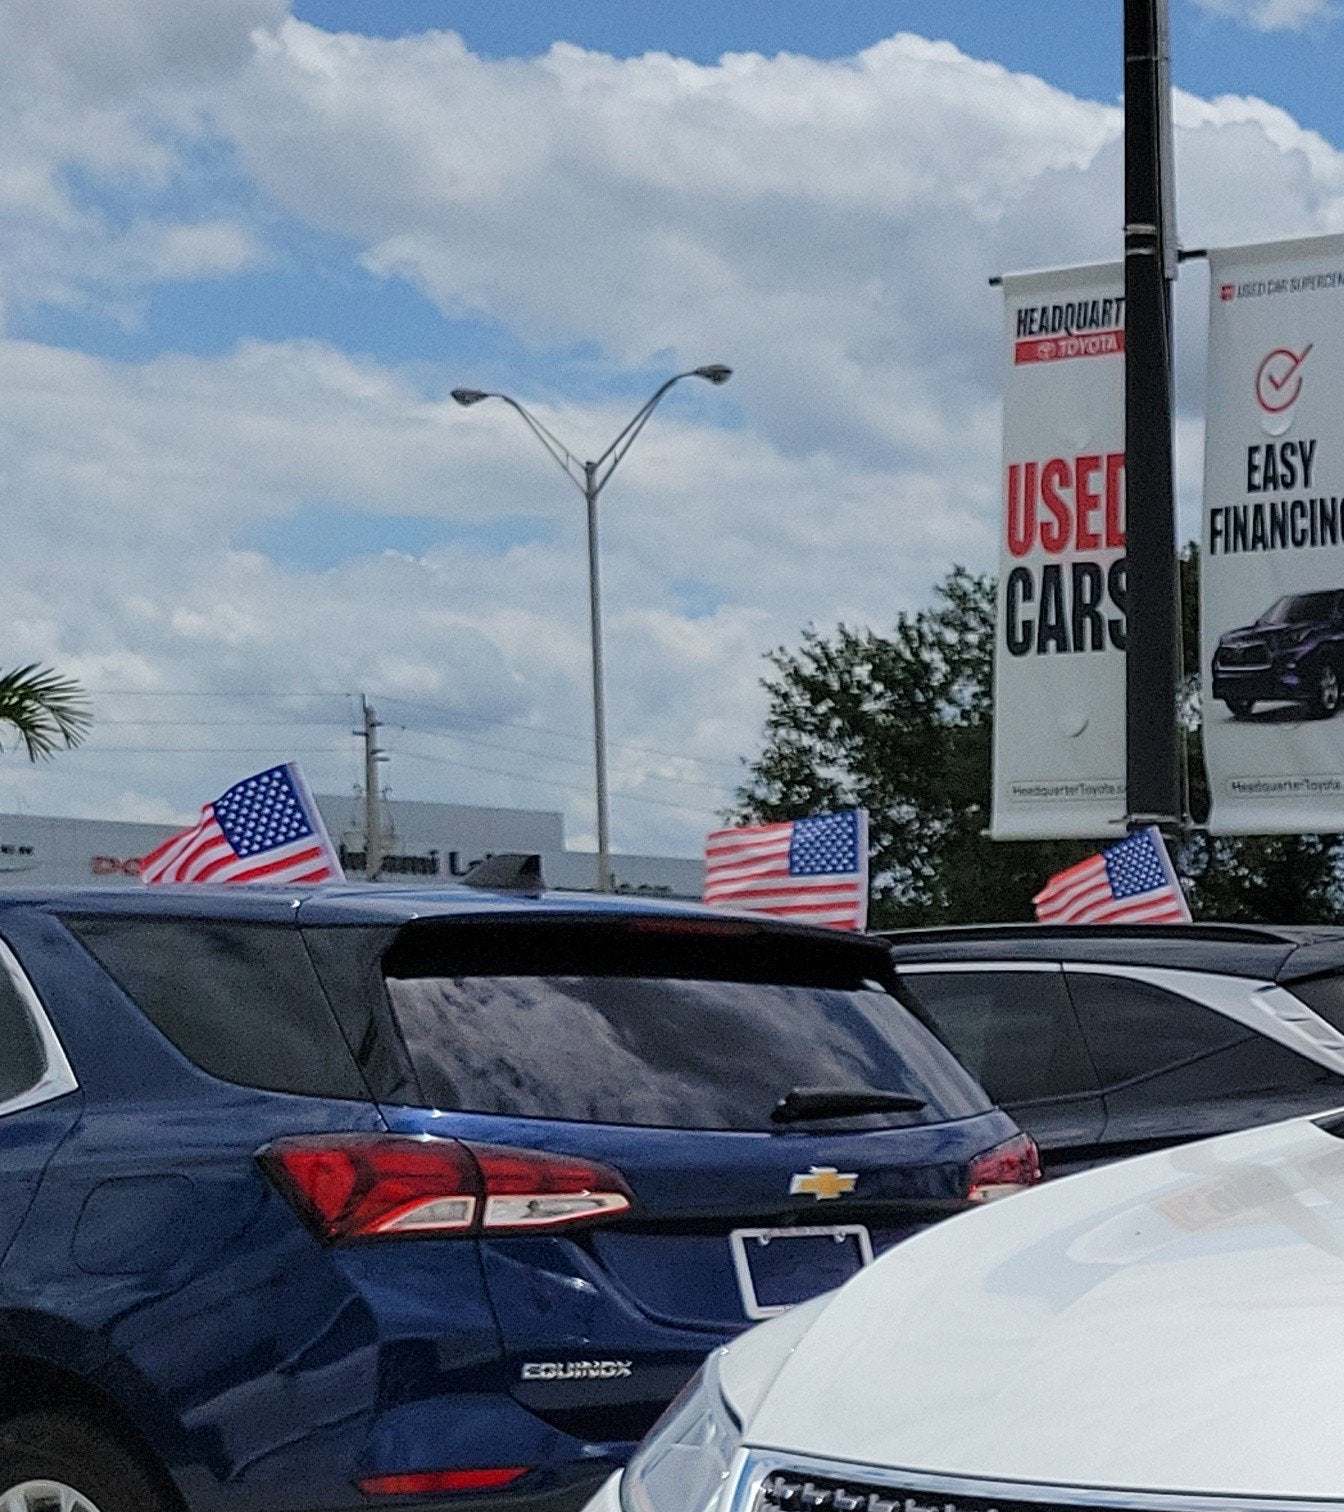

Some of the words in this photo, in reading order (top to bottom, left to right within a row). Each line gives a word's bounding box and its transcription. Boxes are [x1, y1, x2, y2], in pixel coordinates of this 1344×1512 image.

[1016, 297, 1126, 339] HEADQUART
[1057, 334, 1118, 357] TOYOTA
[1247, 439, 1317, 493] EASY
[1006, 557, 1127, 657] CARS
[522, 1359, 633, 1380] EQUINOX
